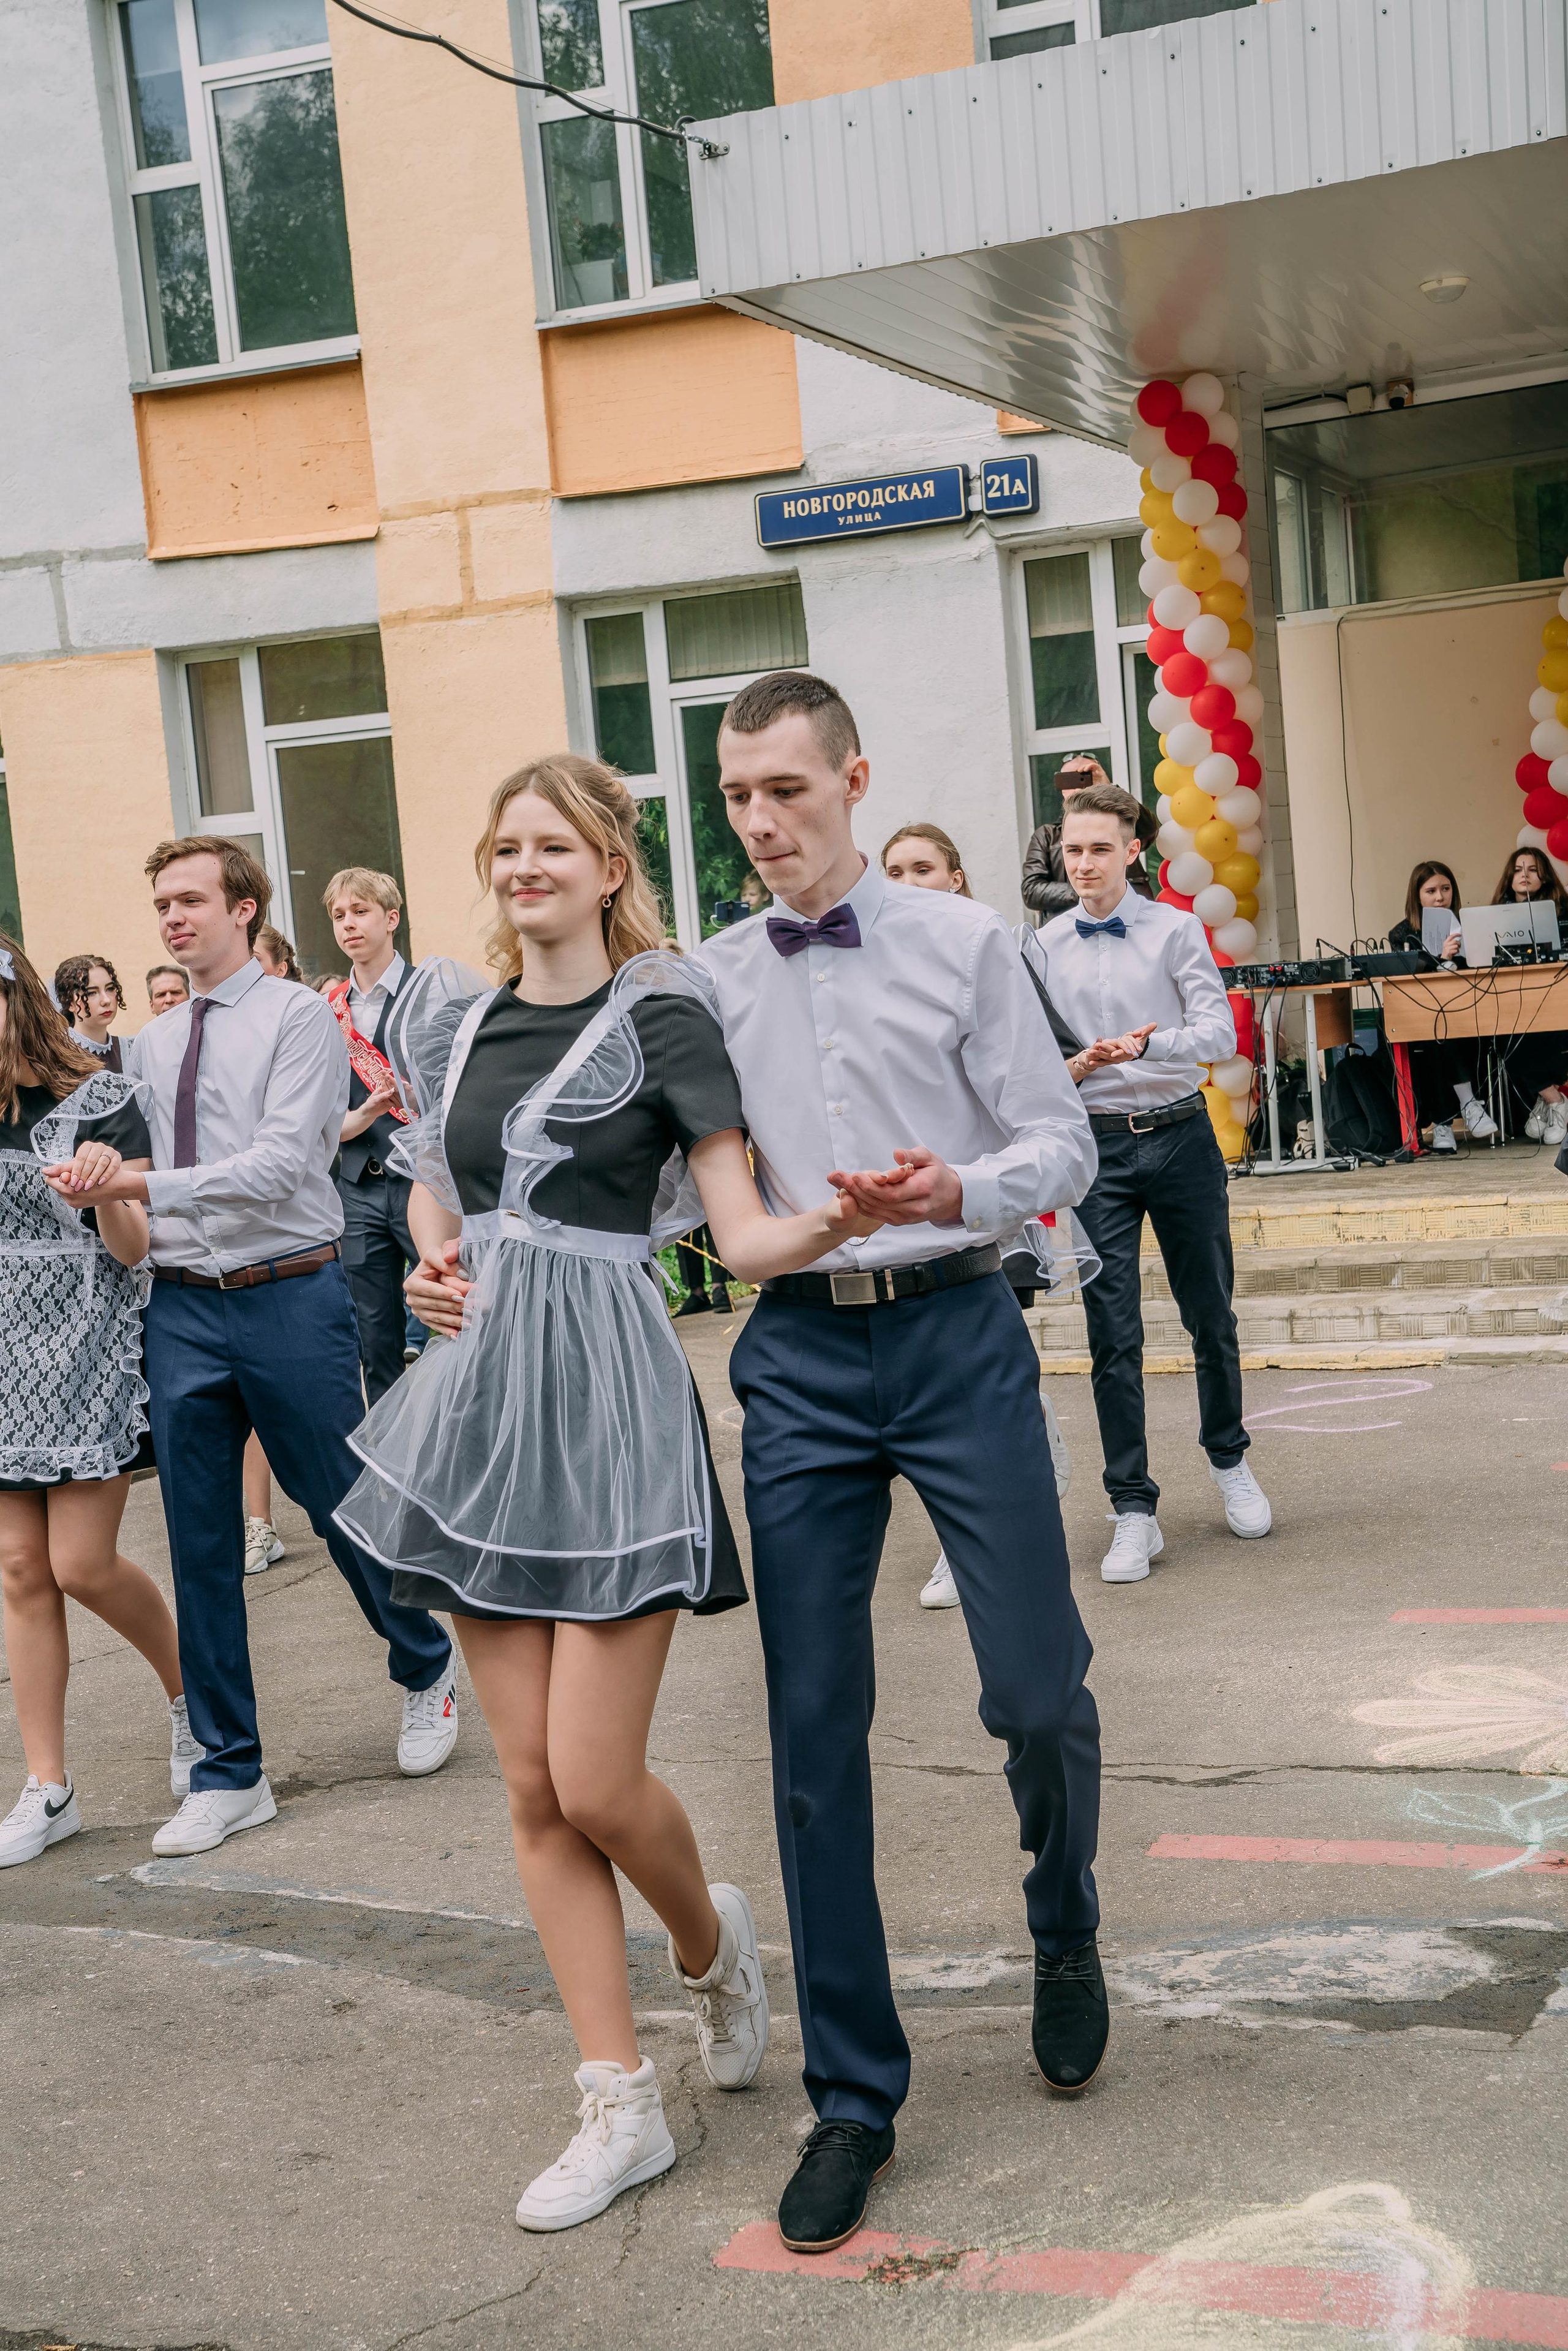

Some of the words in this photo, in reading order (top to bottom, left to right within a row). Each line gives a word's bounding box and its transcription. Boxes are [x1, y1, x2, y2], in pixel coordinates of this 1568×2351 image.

[986, 474, 1027, 499] 21А
[783, 480, 935, 518] НОВГОРОДСКАЯ
[837, 511, 881, 526] УЛИЦА
[1494, 930, 1525, 938] VAIO
